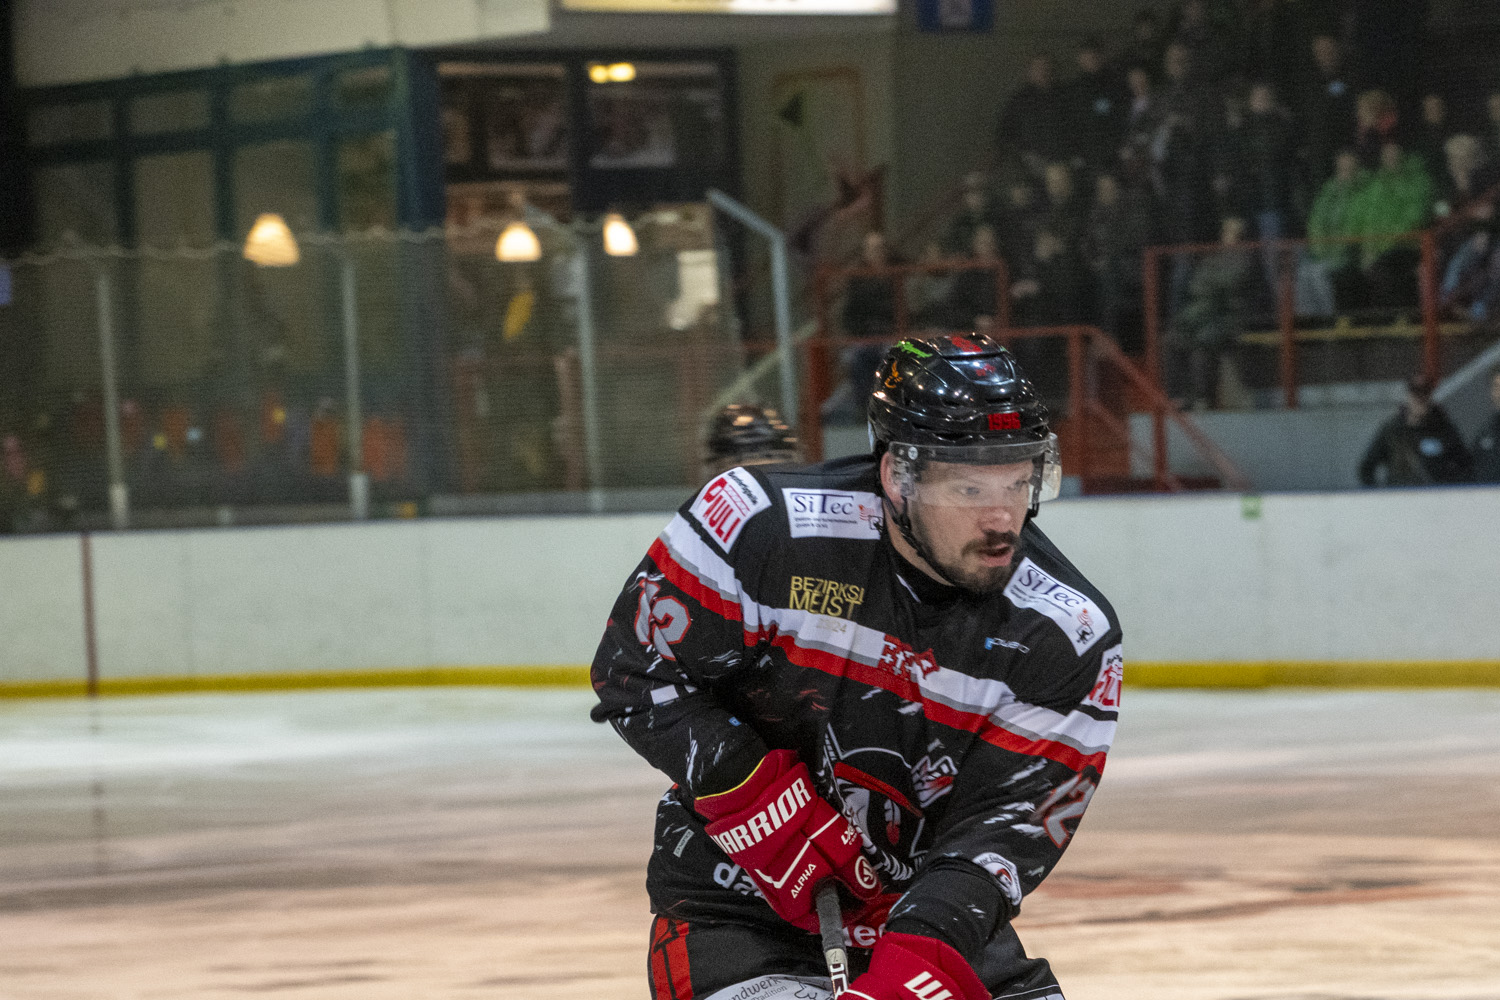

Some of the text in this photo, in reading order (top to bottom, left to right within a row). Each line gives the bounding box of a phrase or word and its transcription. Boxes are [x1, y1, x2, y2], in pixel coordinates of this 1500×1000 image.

[791, 492, 854, 517] SiTec
[1018, 564, 1087, 608] SiTec
[790, 863, 817, 898] ALPHA
